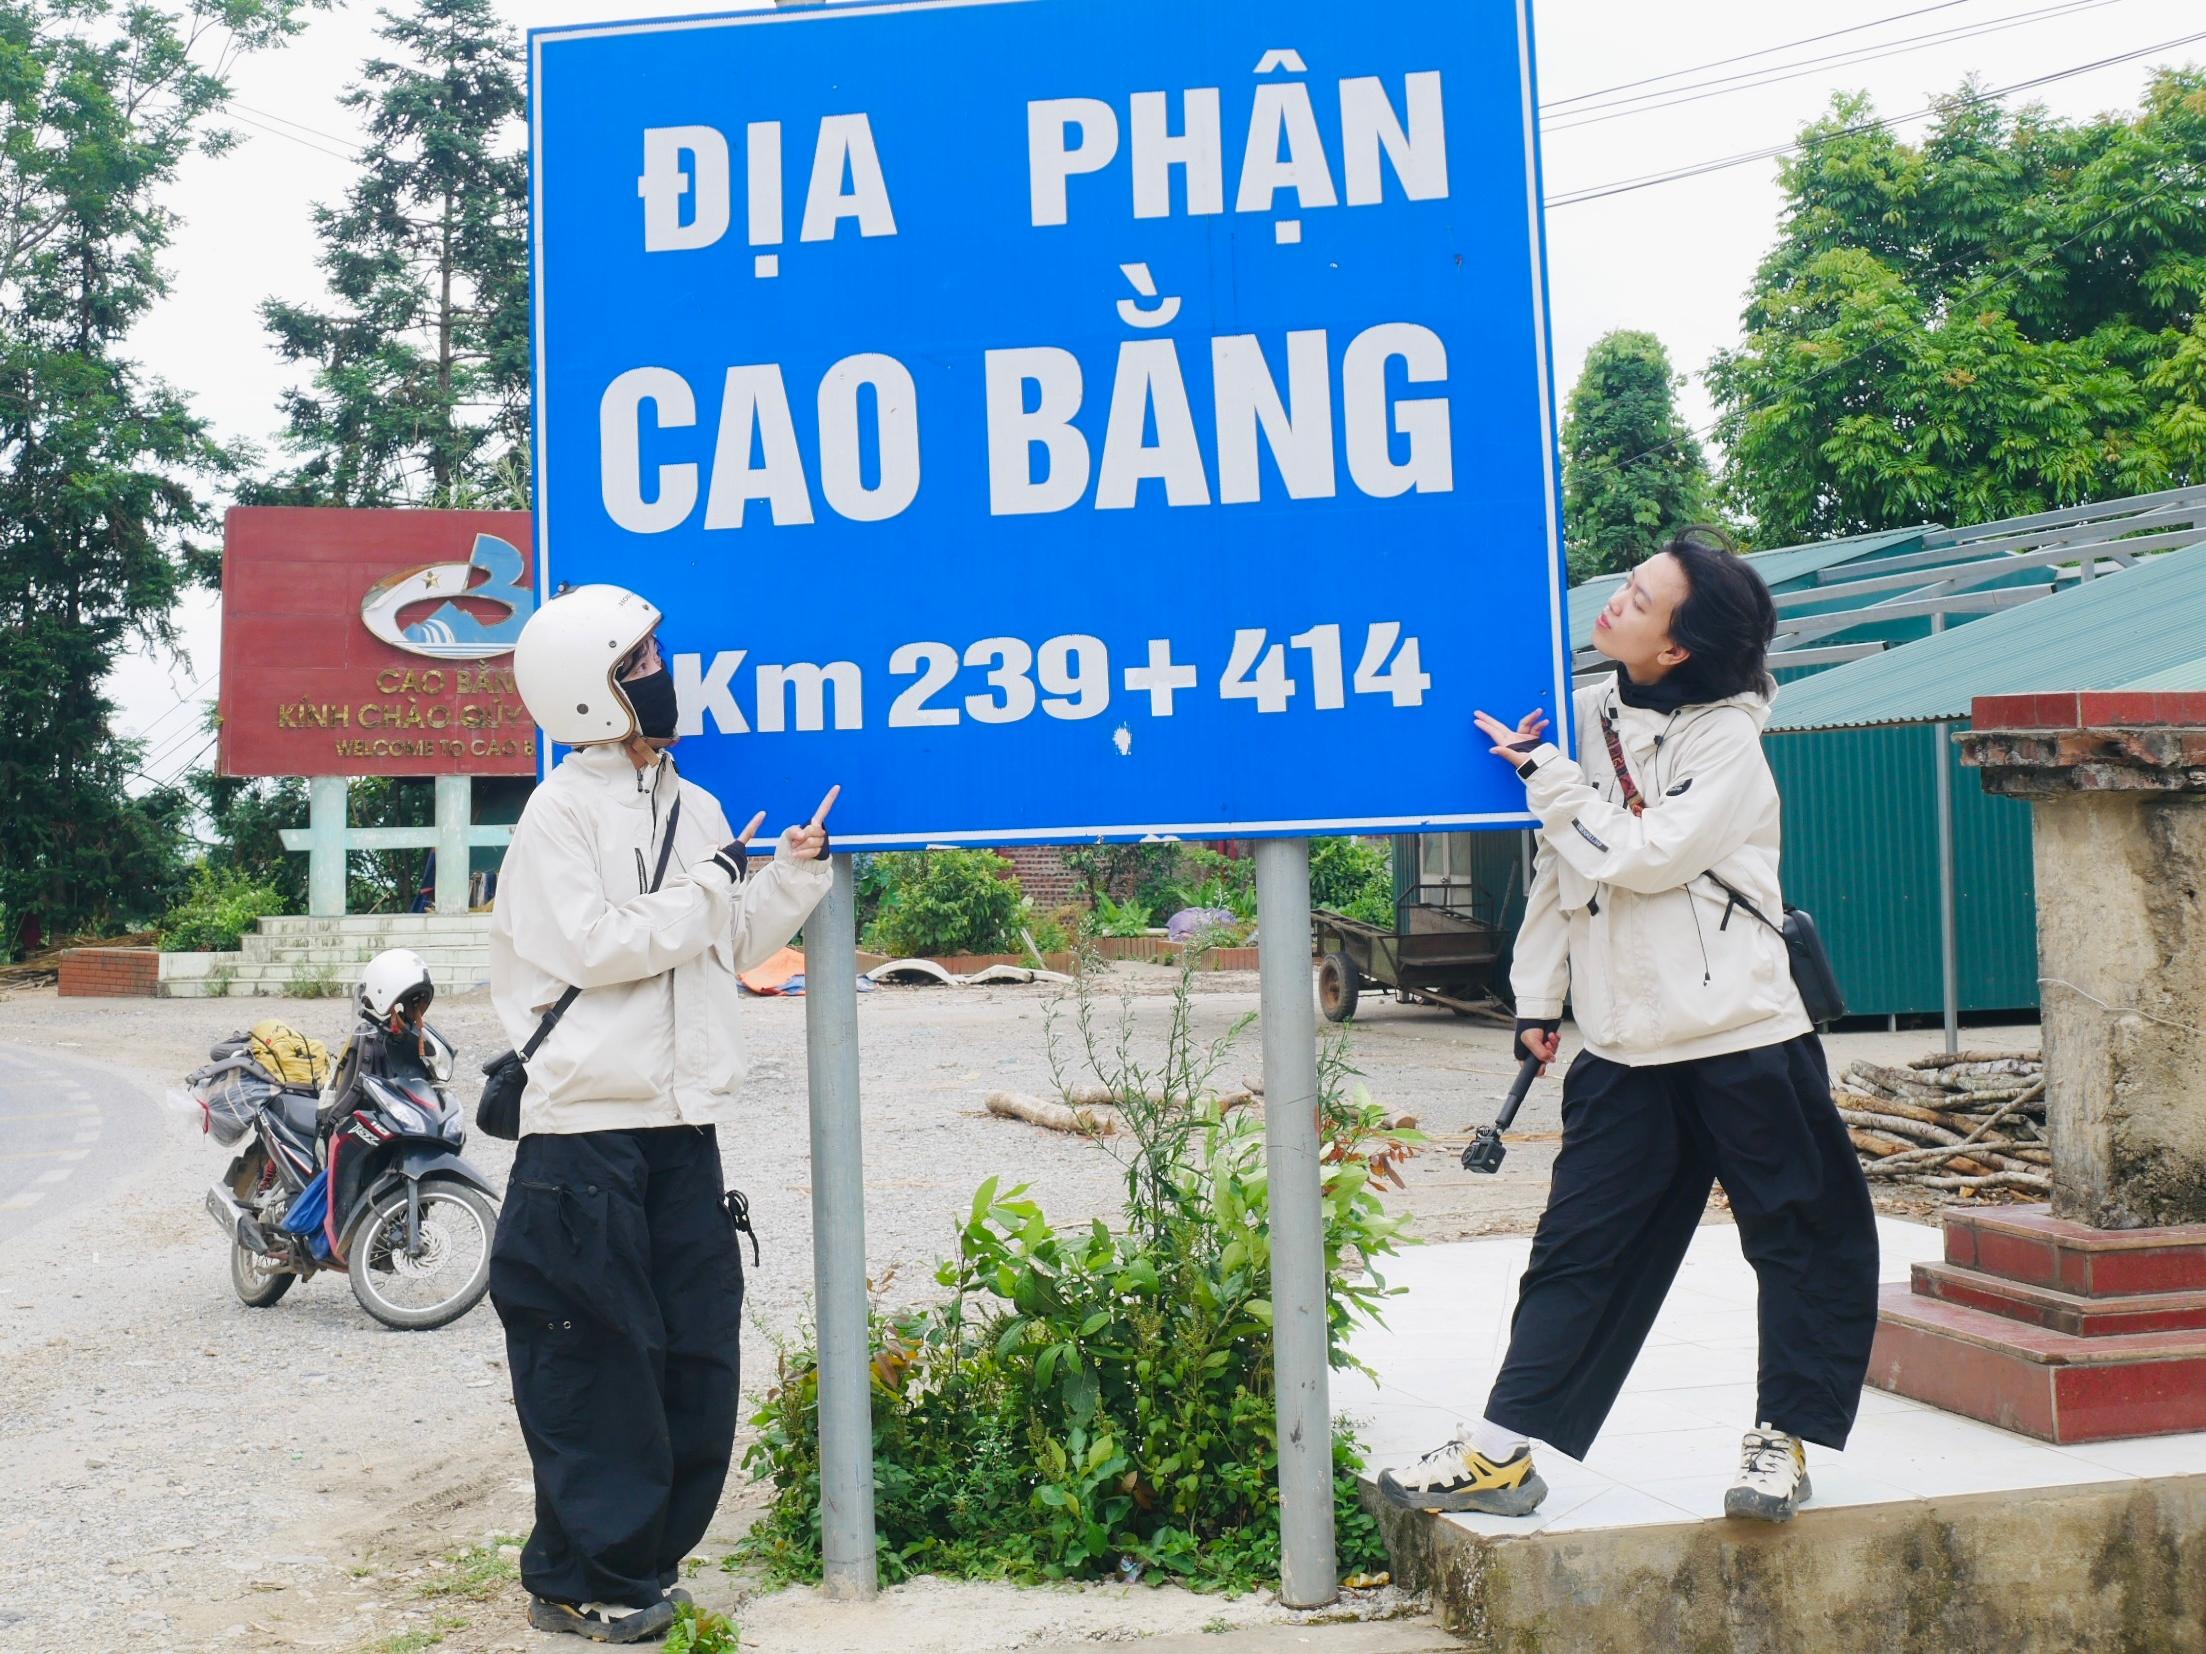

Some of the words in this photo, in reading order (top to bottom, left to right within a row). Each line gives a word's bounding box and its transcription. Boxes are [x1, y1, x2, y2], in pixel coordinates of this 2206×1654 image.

[638, 113, 897, 277] ĐỊA
[1028, 50, 1448, 243] PHẬN
[600, 354, 920, 533] CAO
[986, 263, 1452, 515] BẰNG
[376, 669, 446, 695] CAO
[456, 659, 515, 694] BẰN
[674, 651, 862, 738] Km
[279, 693, 349, 728] KÍNH
[358, 696, 450, 728] CHÀO
[335, 739, 434, 756] WELCOME
[440, 740, 466, 757] TO
[471, 740, 517, 756] CAO
